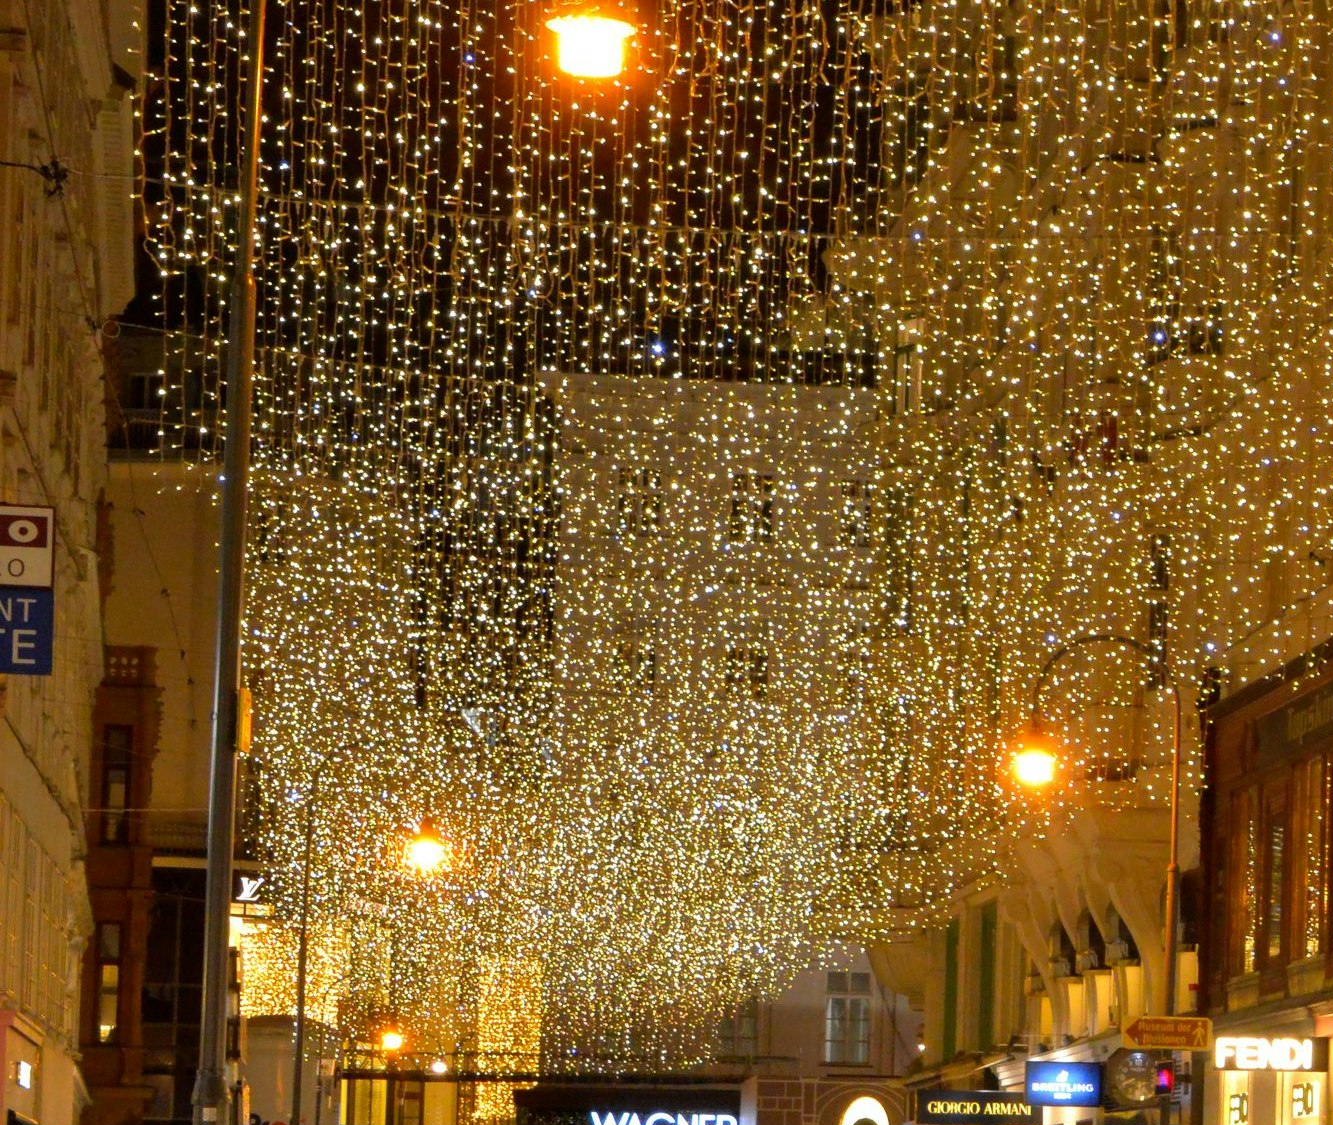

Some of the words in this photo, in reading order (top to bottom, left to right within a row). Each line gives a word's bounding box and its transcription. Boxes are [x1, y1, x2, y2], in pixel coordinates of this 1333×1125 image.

[1139, 1020, 1174, 1032] Museum
[1176, 1022, 1192, 1032] der
[1215, 1037, 1313, 1070] FENDI
[927, 1101, 980, 1115] GIORGIO
[983, 1103, 1032, 1116] ARMANI
